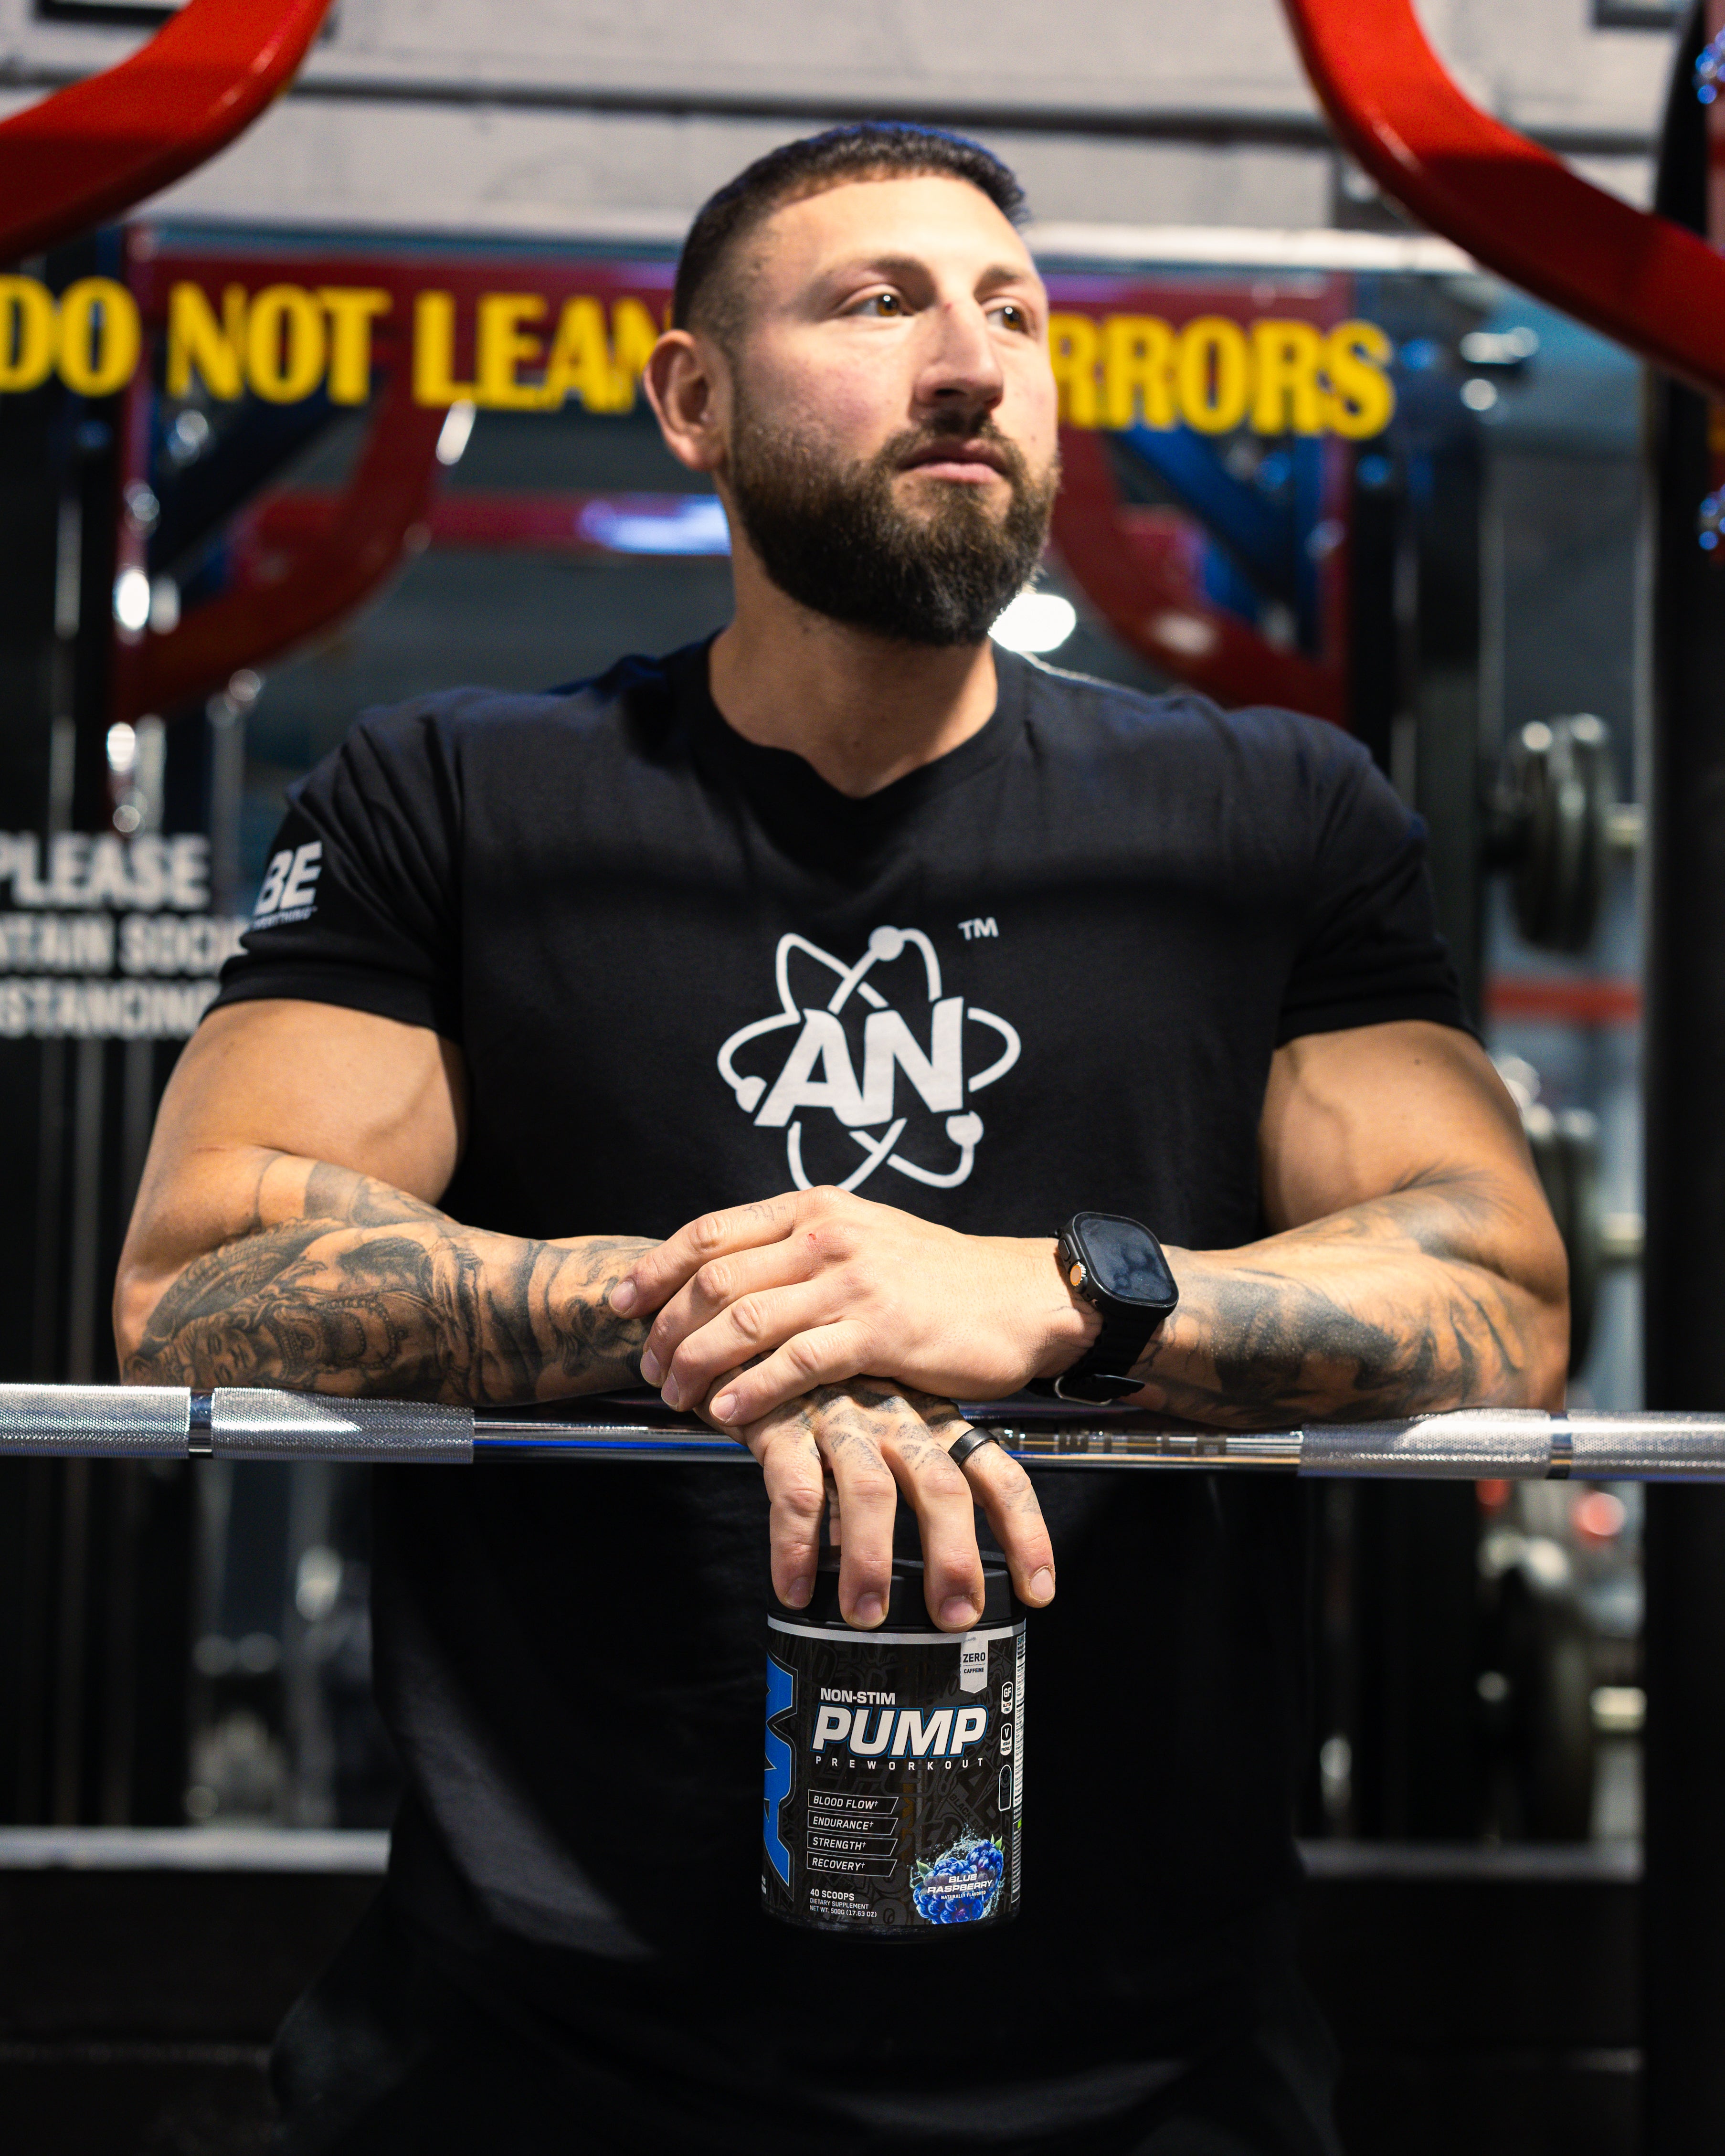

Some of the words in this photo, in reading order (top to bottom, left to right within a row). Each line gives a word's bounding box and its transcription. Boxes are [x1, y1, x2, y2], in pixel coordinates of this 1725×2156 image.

[0, 273, 142, 397] DO
[165, 279, 392, 406] NOT
[1049, 313, 1393, 440] RRORS
[254, 839, 323, 917] BE
[957, 916, 999, 941] TM
[753, 995, 964, 1128] AN
[963, 1652, 985, 1663] ZERO
[820, 1688, 896, 1705] NON-STIM
[1004, 1687, 1012, 1698] GF
[811, 1703, 988, 1758] PUMP
[816, 1756, 984, 1770] PREWORKOUT
[813, 1795, 844, 1807] BLOOD
[948, 1873, 978, 1883] BLUE
[927, 1880, 993, 1893] RASPBERRY
[810, 1889, 820, 1897] 40
[822, 1890, 855, 1901] SCOOPS
[810, 1898, 831, 1906] DIETARY
[832, 1901, 869, 1910] SUPPLEMENT
